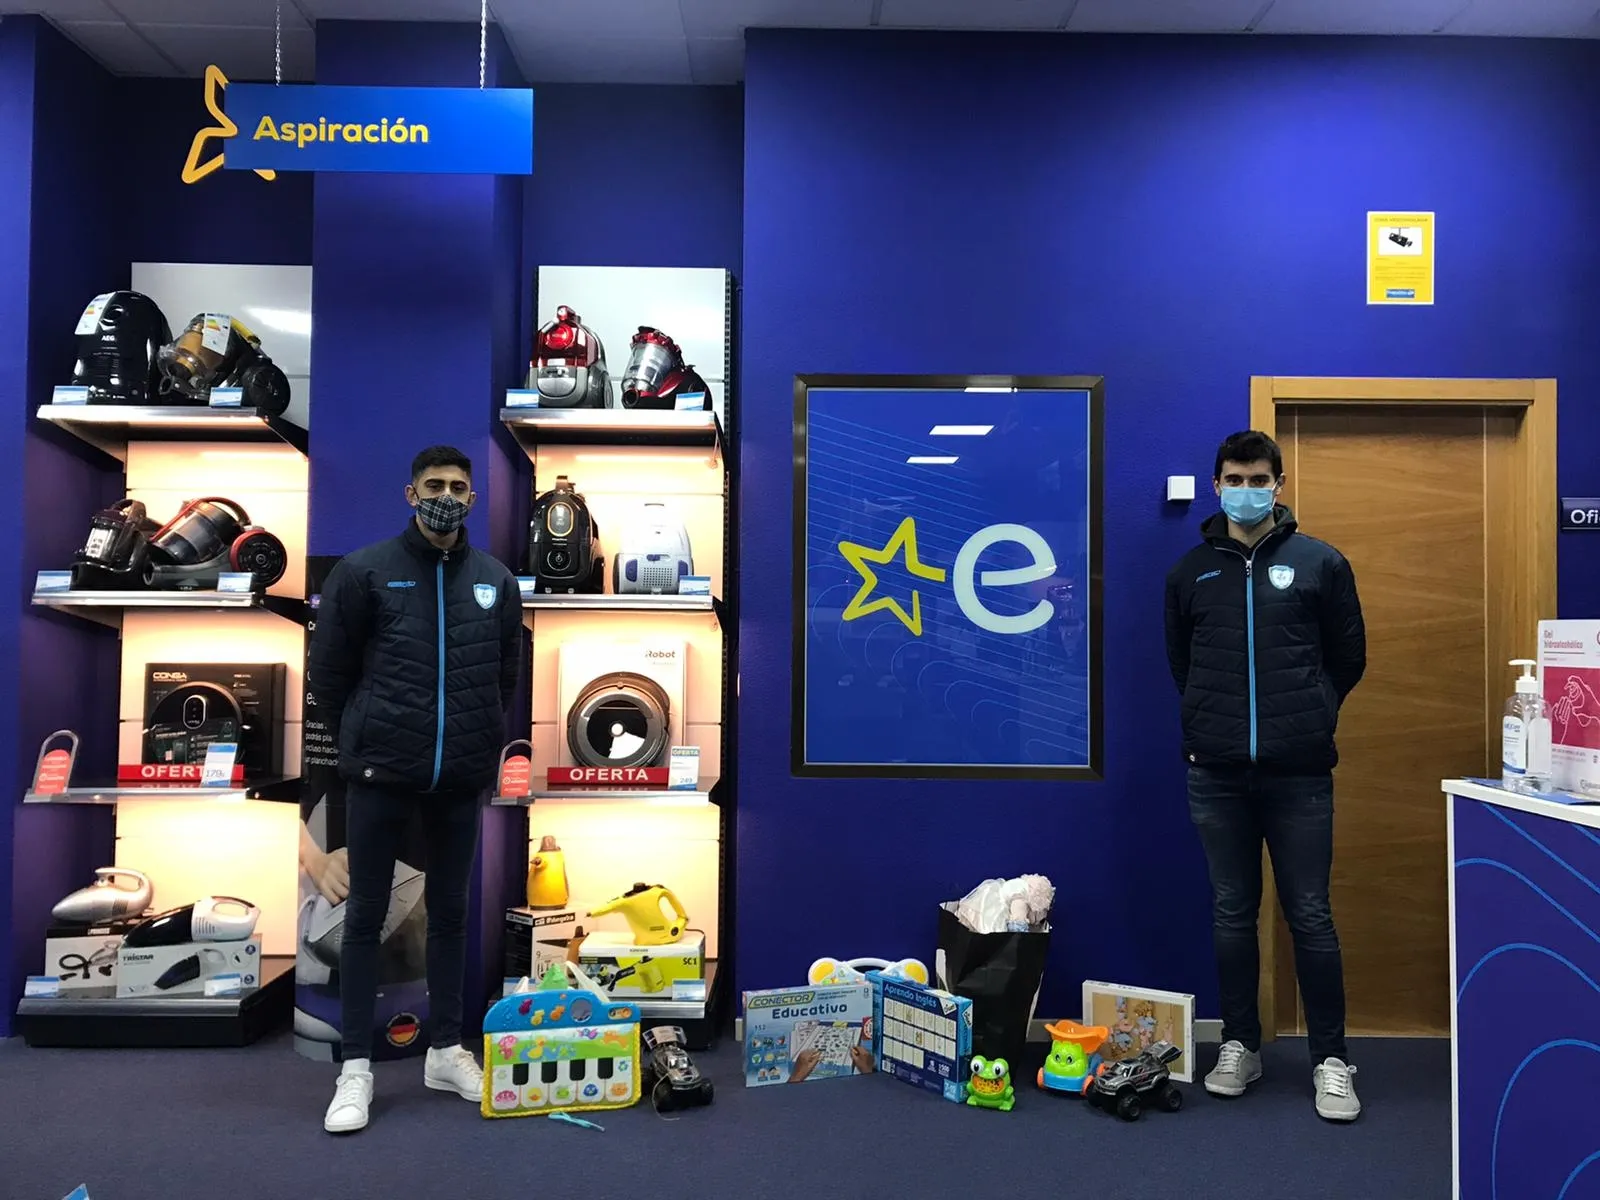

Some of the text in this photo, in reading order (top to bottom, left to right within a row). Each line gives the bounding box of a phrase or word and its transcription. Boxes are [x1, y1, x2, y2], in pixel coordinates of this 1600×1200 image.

[253, 115, 429, 148] Aspiración
[1570, 509, 1600, 524] Ofi
[141, 765, 205, 778] OFERT
[569, 768, 649, 781] OFERTA
[753, 994, 810, 1007] CONECTOR
[772, 1003, 848, 1019] Educativo
